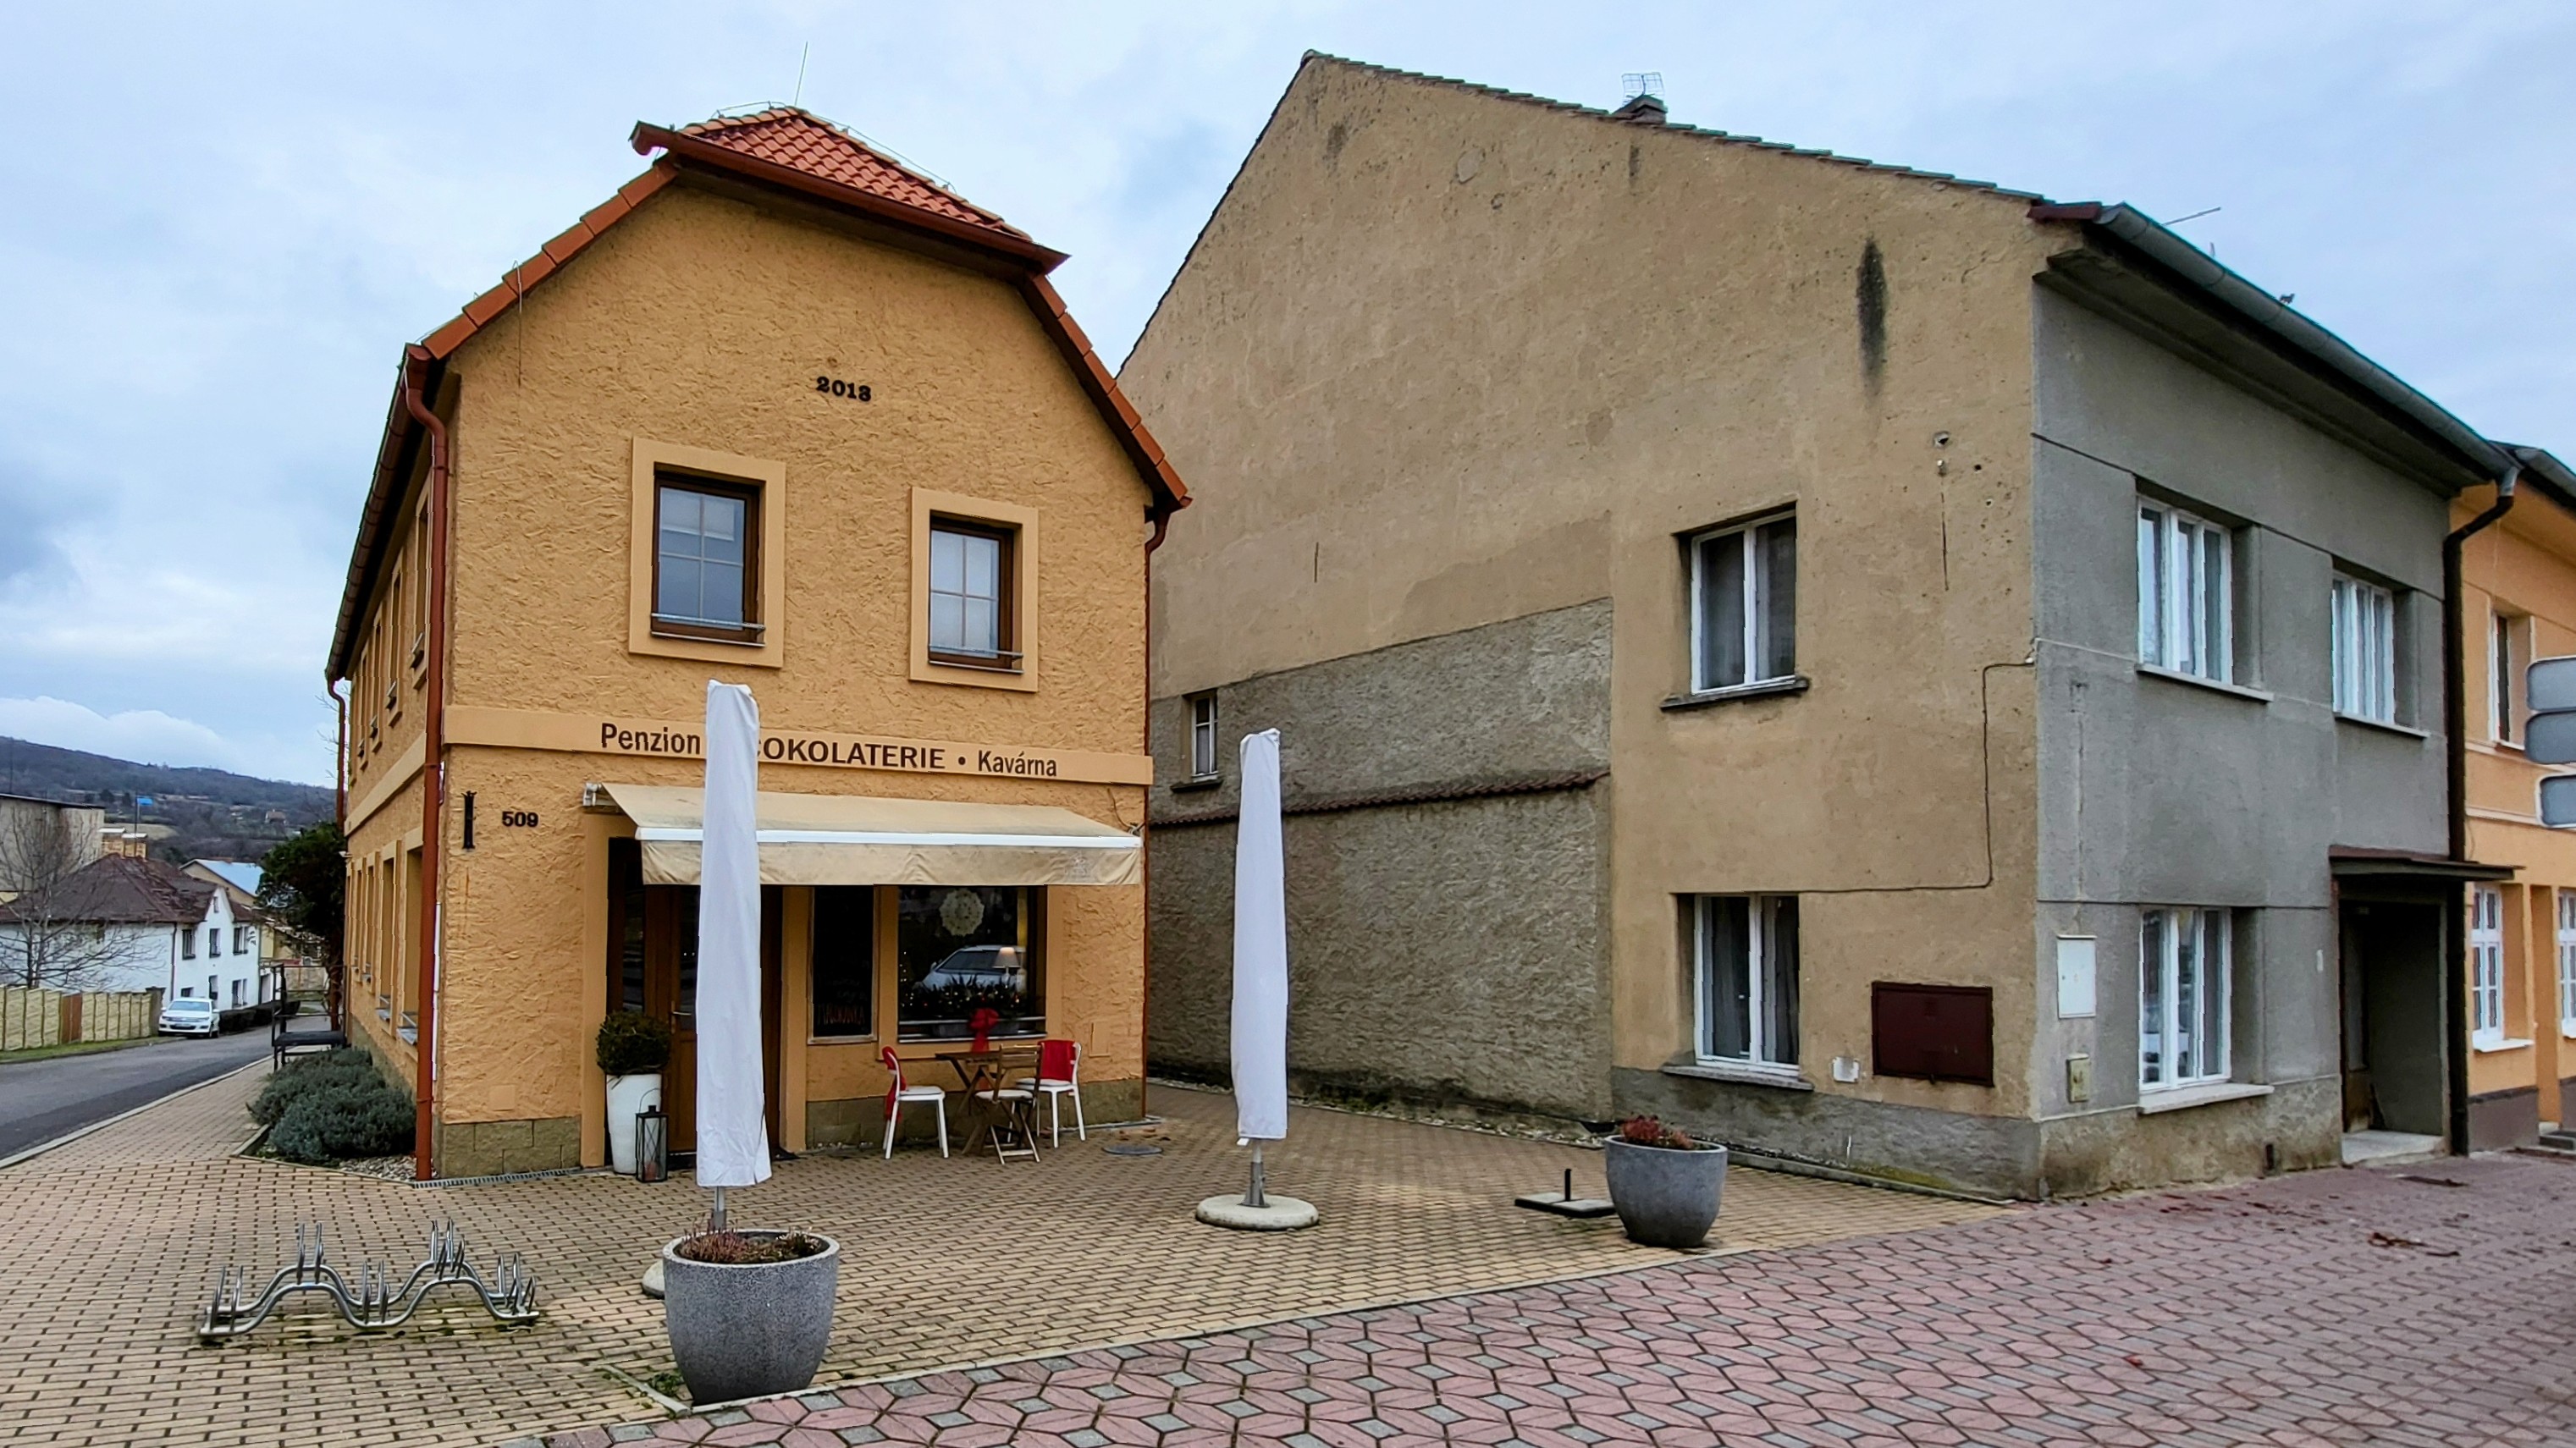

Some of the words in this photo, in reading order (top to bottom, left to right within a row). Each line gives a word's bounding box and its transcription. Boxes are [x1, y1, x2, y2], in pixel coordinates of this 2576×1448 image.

[601, 722, 702, 755] Penzion
[757, 737, 946, 769] OKOLATERIE
[978, 750, 1058, 777] Kavárna
[501, 811, 539, 828] 509
